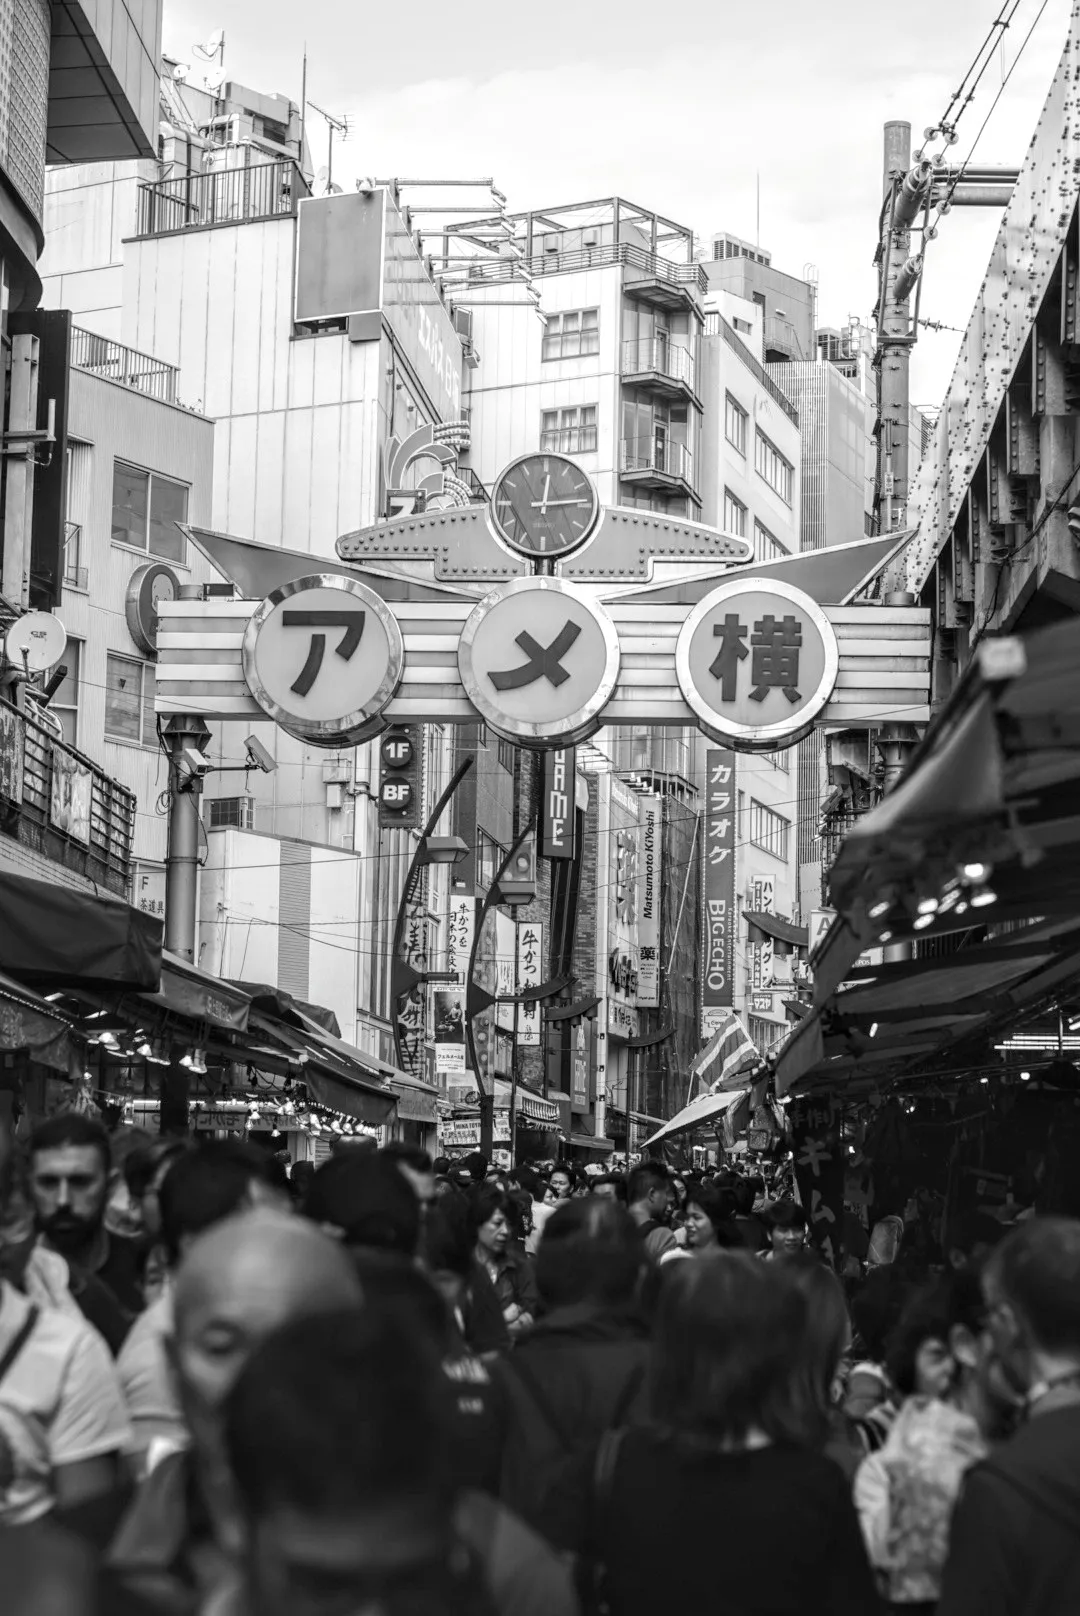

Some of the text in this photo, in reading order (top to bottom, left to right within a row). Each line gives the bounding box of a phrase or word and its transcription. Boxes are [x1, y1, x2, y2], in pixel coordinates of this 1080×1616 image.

[281, 609, 803, 703] アメ横
[385, 742, 410, 758] 1F
[383, 784, 410, 801] BF
[708, 764, 732, 865] カラオケ
[140, 897, 165, 914] 茶道具
[643, 854, 654, 919] Matsumoto
[640, 946, 656, 961] 薬
[707, 899, 726, 991] BIG ECHO
